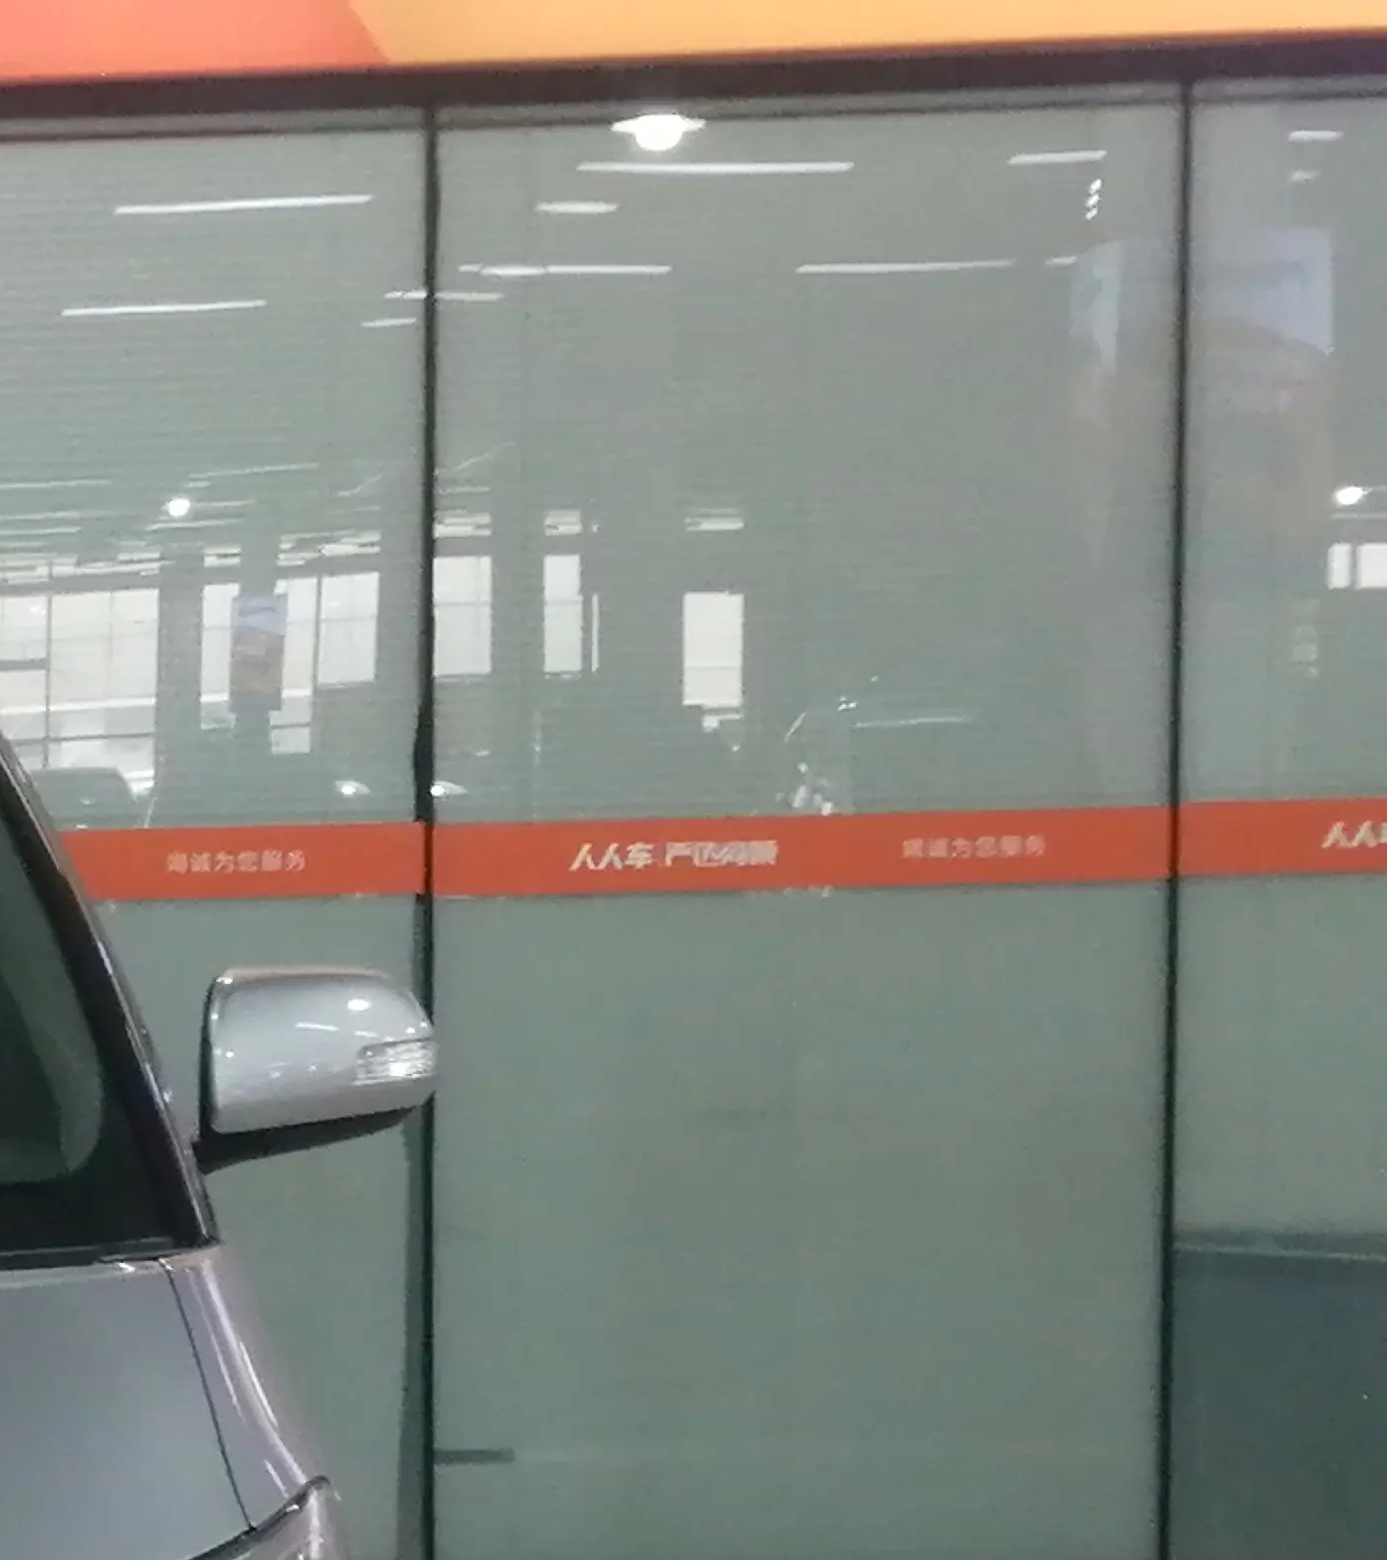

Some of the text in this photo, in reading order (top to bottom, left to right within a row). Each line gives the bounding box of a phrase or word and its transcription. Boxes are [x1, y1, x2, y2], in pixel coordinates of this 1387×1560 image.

[1321, 820, 1387, 848] 人人
[569, 842, 655, 871] 人人车
